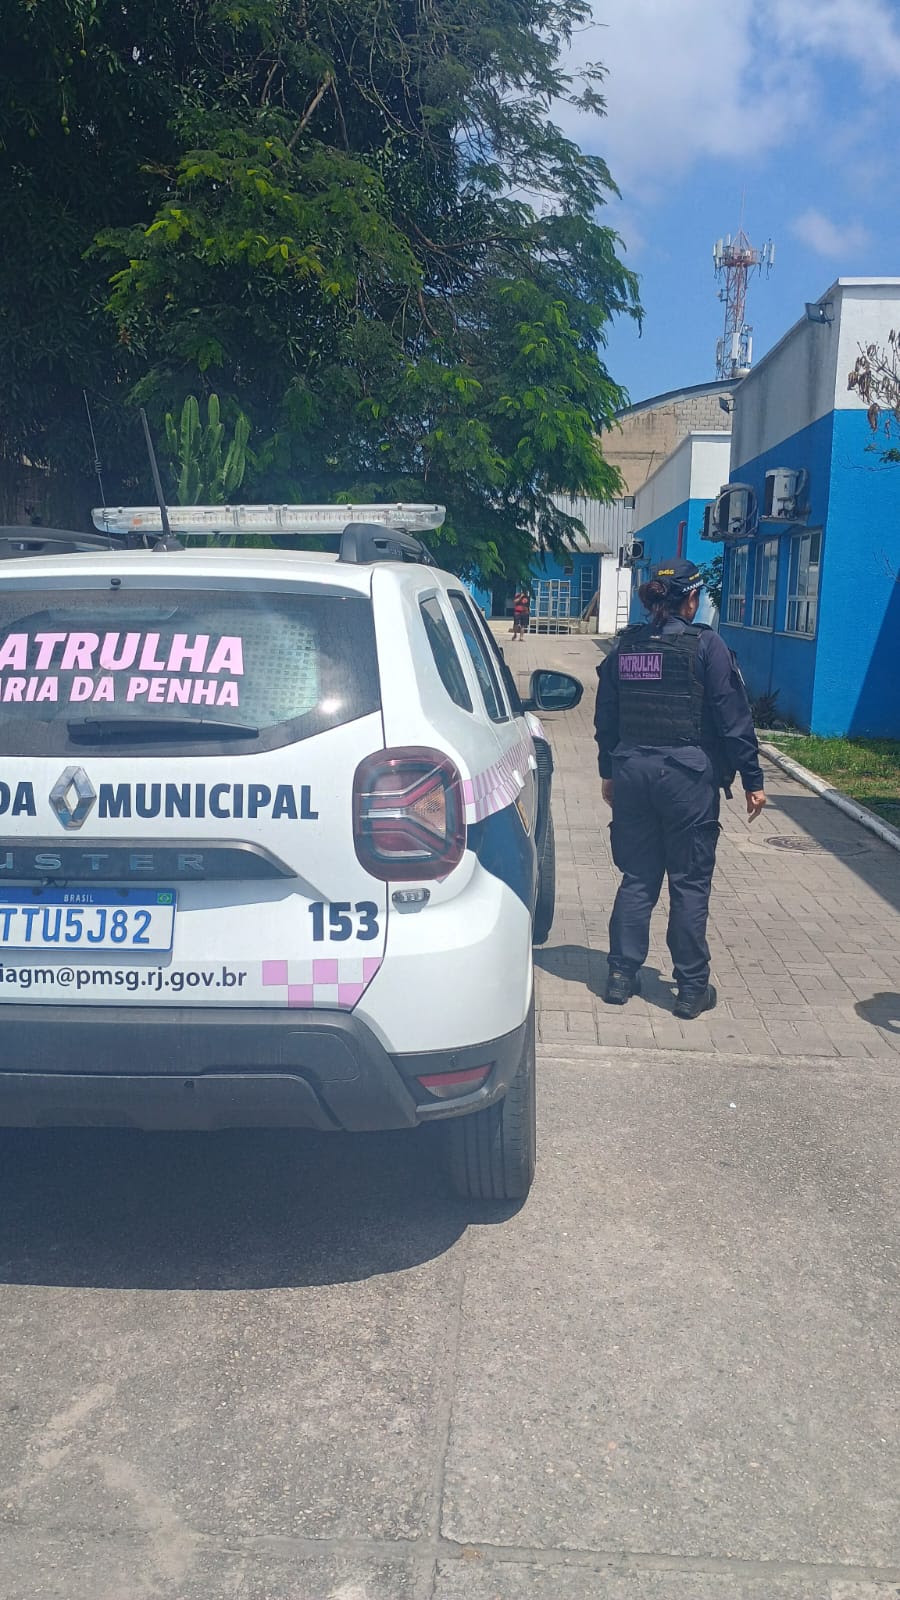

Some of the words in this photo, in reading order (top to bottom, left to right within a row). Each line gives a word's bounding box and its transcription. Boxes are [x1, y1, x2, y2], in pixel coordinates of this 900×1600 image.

[0, 632, 244, 675] ATRULHA
[620, 655, 660, 672] PATRULHA
[0, 676, 59, 702] RIA
[69, 677, 115, 702] DA
[126, 678, 239, 707] PENHA
[98, 783, 319, 820] MUNICIPAL
[63, 894, 94, 903] BRASIL
[0, 908, 152, 944] TTU5J82
[308, 901, 380, 942] 153
[0, 963, 248, 991] iagm@pmsg.rj.gov.br
